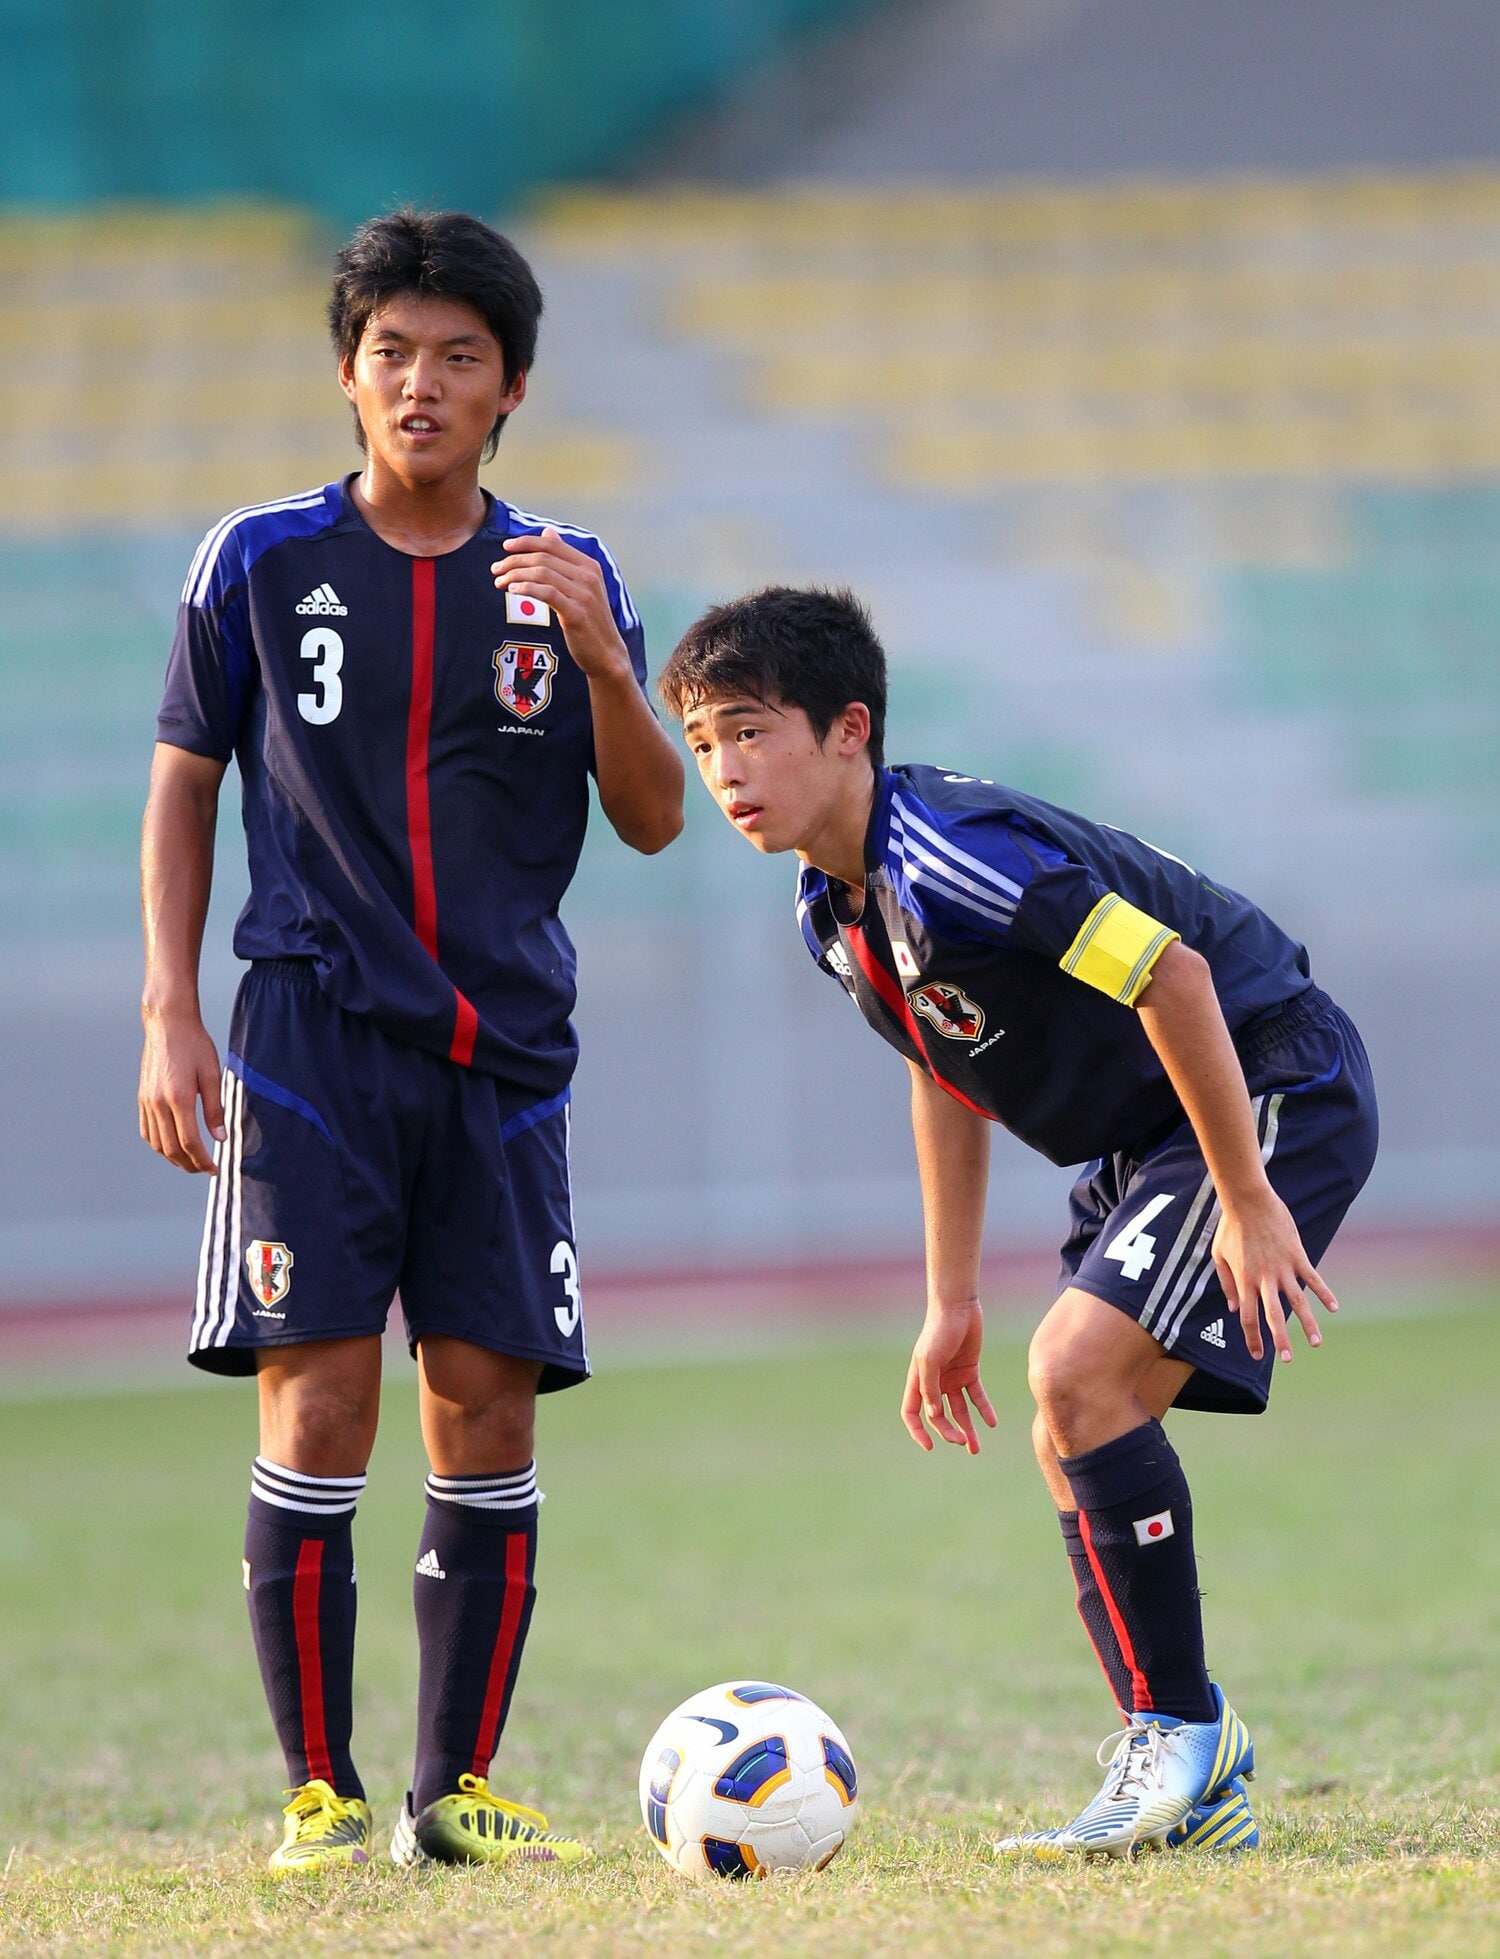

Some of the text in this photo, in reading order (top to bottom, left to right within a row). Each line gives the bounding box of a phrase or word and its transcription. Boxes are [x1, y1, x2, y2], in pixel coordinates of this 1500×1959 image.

[295, 602, 348, 616] adidas
[504, 651, 547, 667] JFA
[297, 627, 344, 725] 3
[498, 725, 545, 736] JAPAN
[969, 1029, 1005, 1057] JAPAN
[1104, 1193, 1176, 1281] 4
[550, 1240, 580, 1337] 3
[252, 1310, 286, 1319] JAPAN
[1200, 1330, 1226, 1348] adidas
